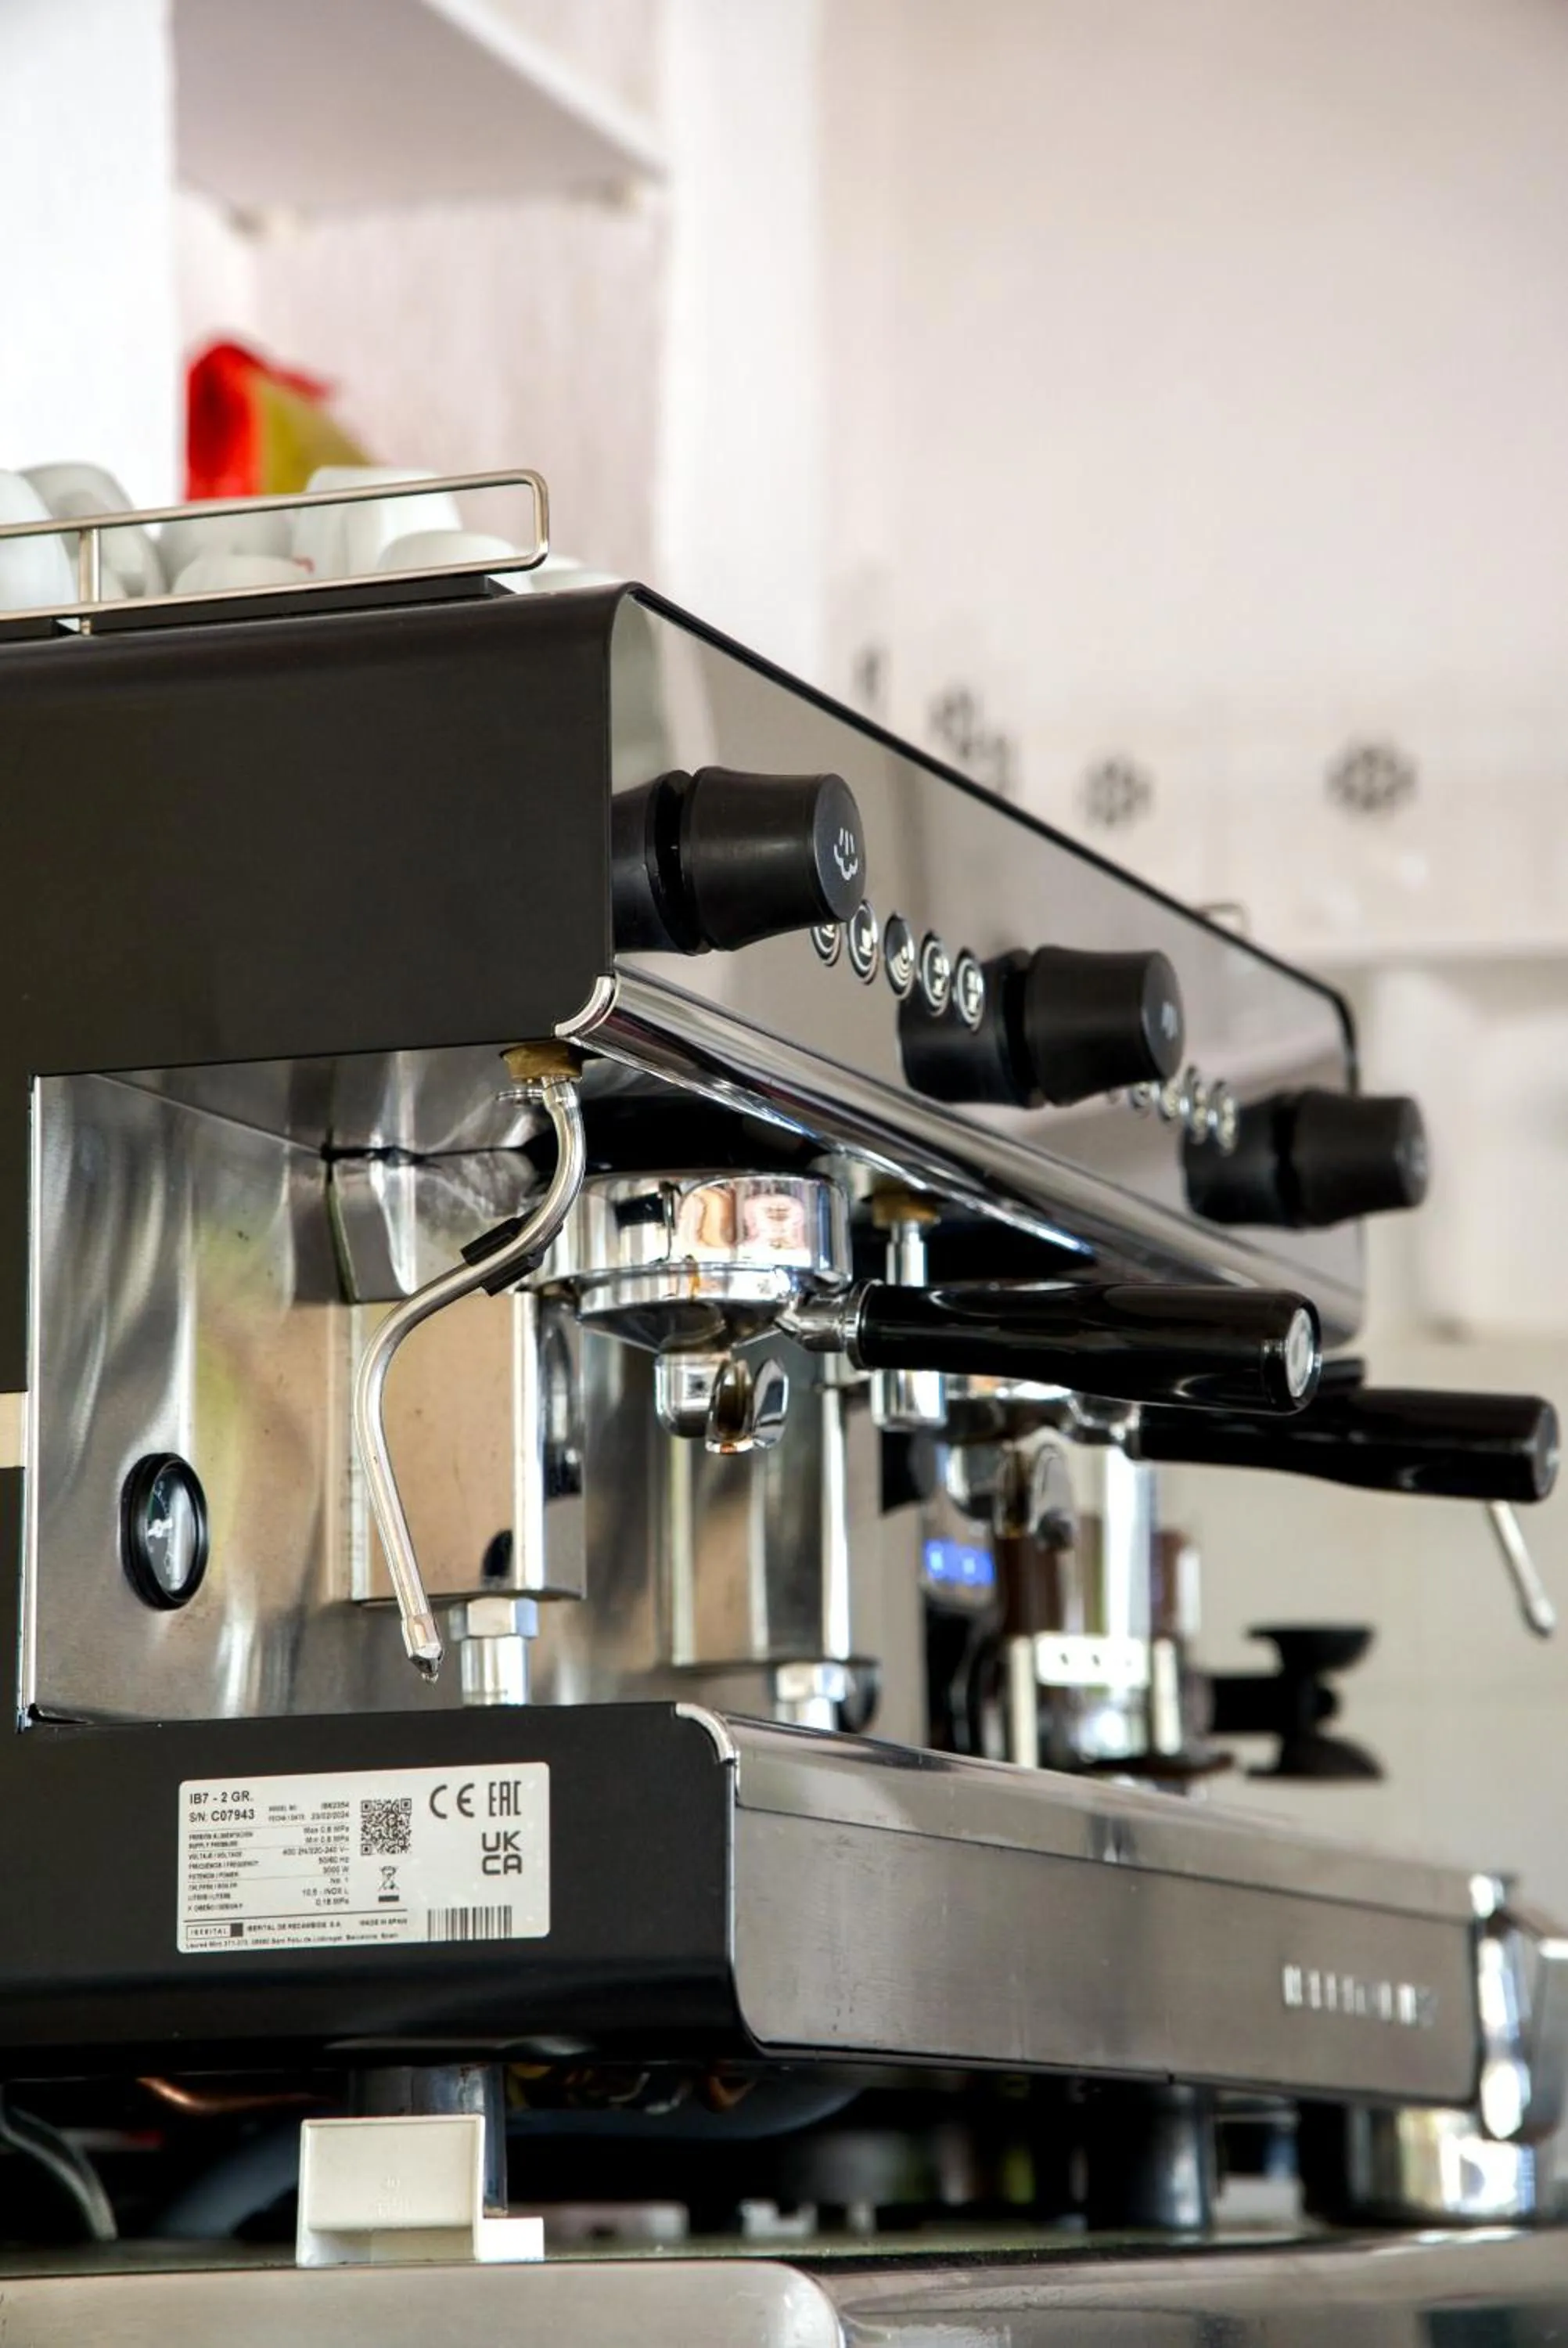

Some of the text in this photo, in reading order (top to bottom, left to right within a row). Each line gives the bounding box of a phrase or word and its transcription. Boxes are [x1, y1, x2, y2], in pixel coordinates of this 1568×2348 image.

[189, 1792, 209, 1805] IB7
[221, 1791, 228, 1803] 2
[429, 1783, 475, 1820] CE
[210, 1809, 255, 1821] C07943
[481, 1830, 522, 1853] UK
[481, 1853, 523, 1876] CA
